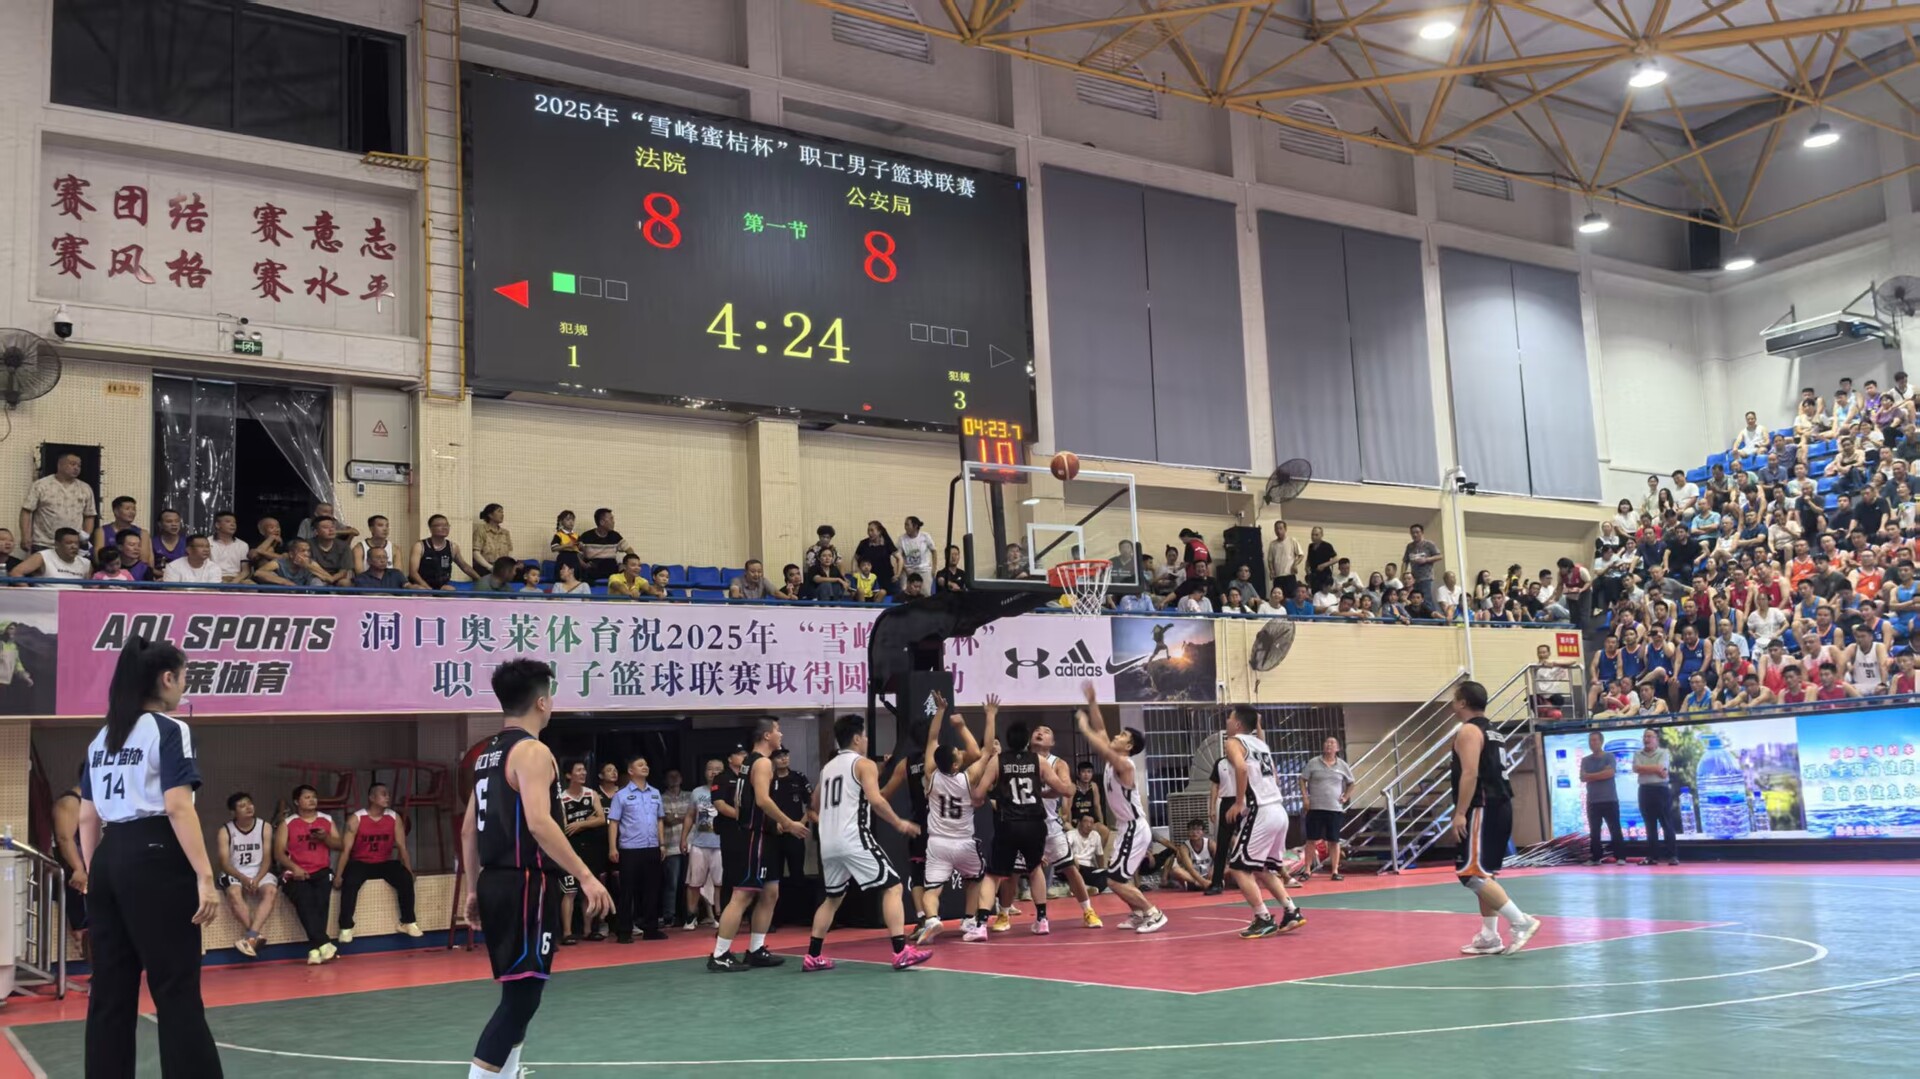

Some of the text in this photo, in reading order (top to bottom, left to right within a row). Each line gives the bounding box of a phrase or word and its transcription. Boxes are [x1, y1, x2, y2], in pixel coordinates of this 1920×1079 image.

[635, 145, 688, 175] 法院
[845, 186, 912, 217] 公安局
[50, 173, 397, 261] 赛团结 赛意志
[642, 191, 683, 250] 8
[743, 212, 808, 240] 第一节
[863, 230, 898, 284] 8
[49, 231, 397, 314] 赛风格 赛水平
[559, 321, 589, 337] 犯规
[706, 301, 852, 364] 4:24
[567, 345, 581, 368] 1
[947, 370, 971, 383] 犯规
[953, 390, 967, 410] 3
[963, 416, 1022, 441] 04:23.7
[979, 438, 1016, 473] 10
[183, 614, 337, 652] SPORTS
[184, 660, 292, 696] 莱体育
[1054, 662, 1103, 678] adidas
[102, 772, 126, 801] 14
[823, 773, 844, 811] 10
[1008, 776, 1037, 806] 12
[937, 794, 963, 820] 15
[239, 852, 253, 866] 13
[541, 931, 553, 956] 6
